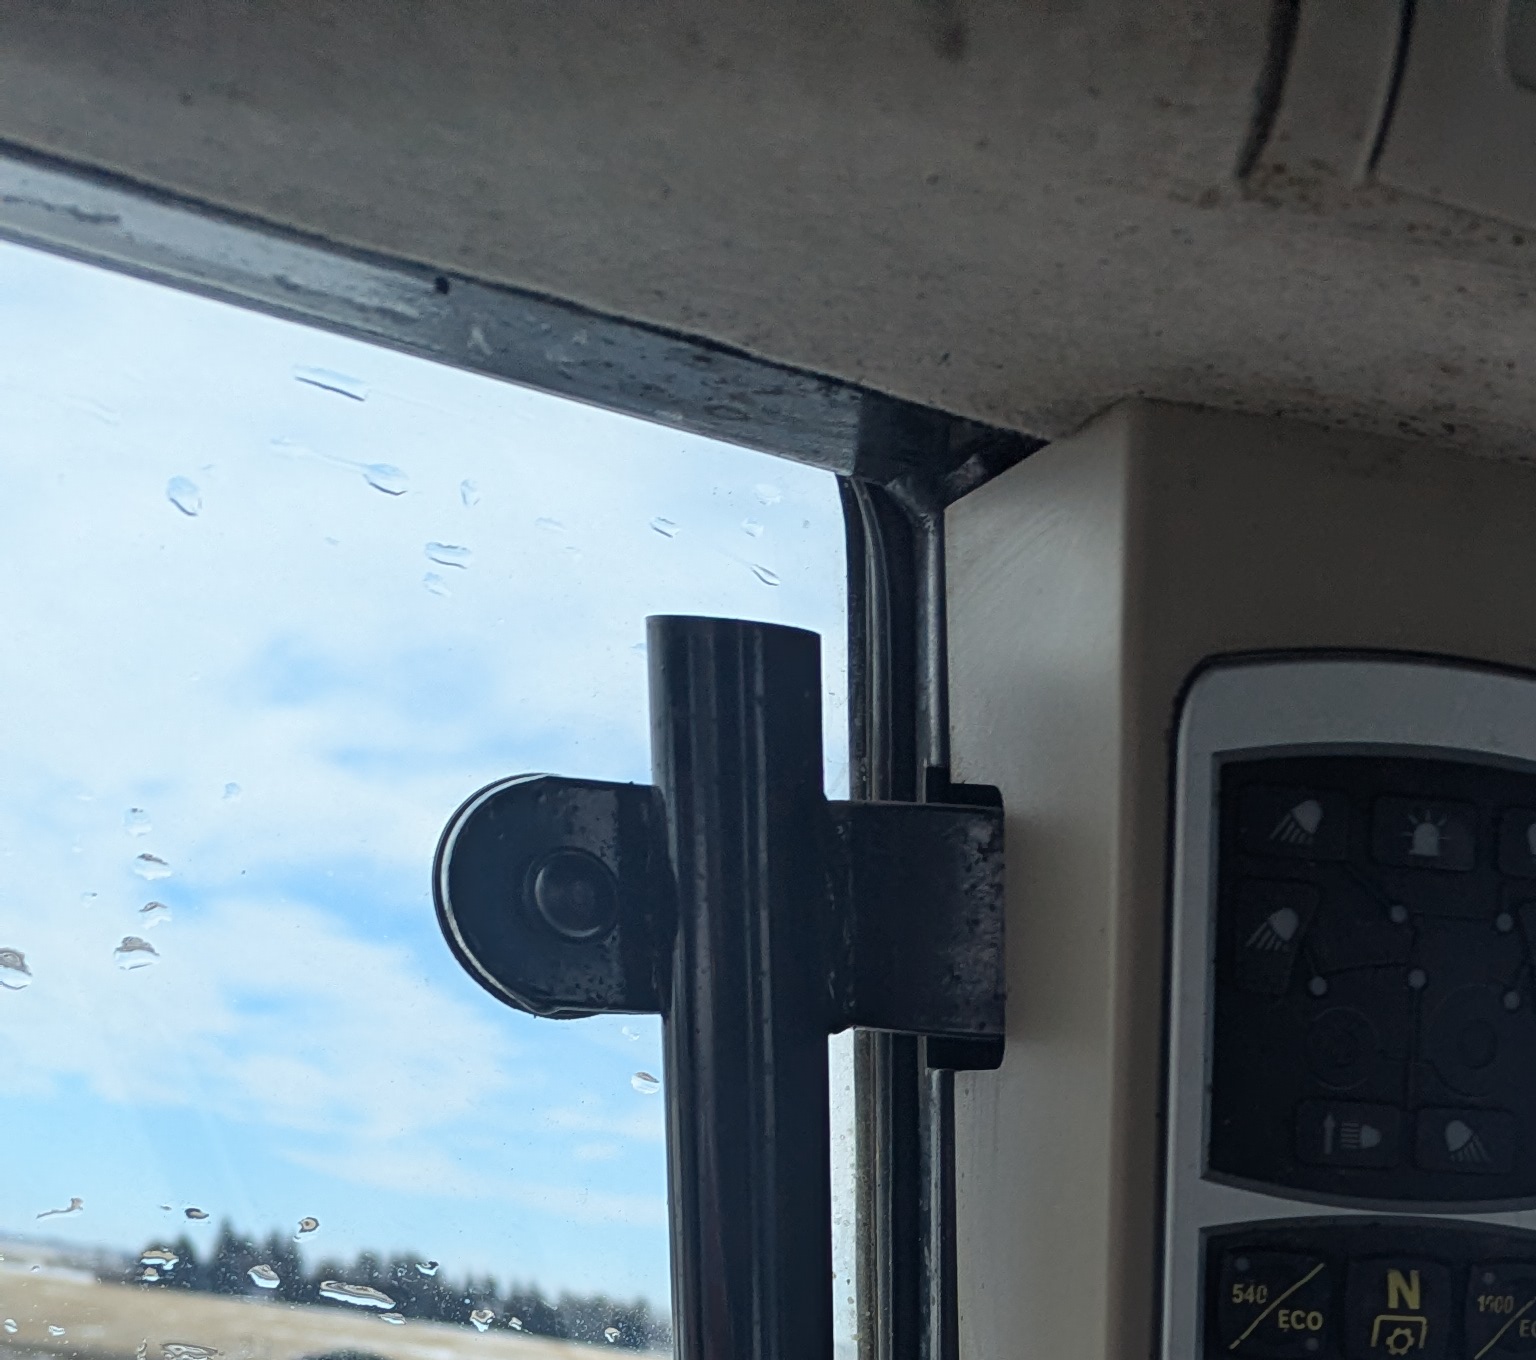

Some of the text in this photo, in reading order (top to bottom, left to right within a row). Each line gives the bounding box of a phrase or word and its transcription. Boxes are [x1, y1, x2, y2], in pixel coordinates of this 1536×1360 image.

[1231, 1283, 1268, 1305] 540
[1386, 1268, 1421, 1310] N
[1277, 1309, 1323, 1332] ECO
